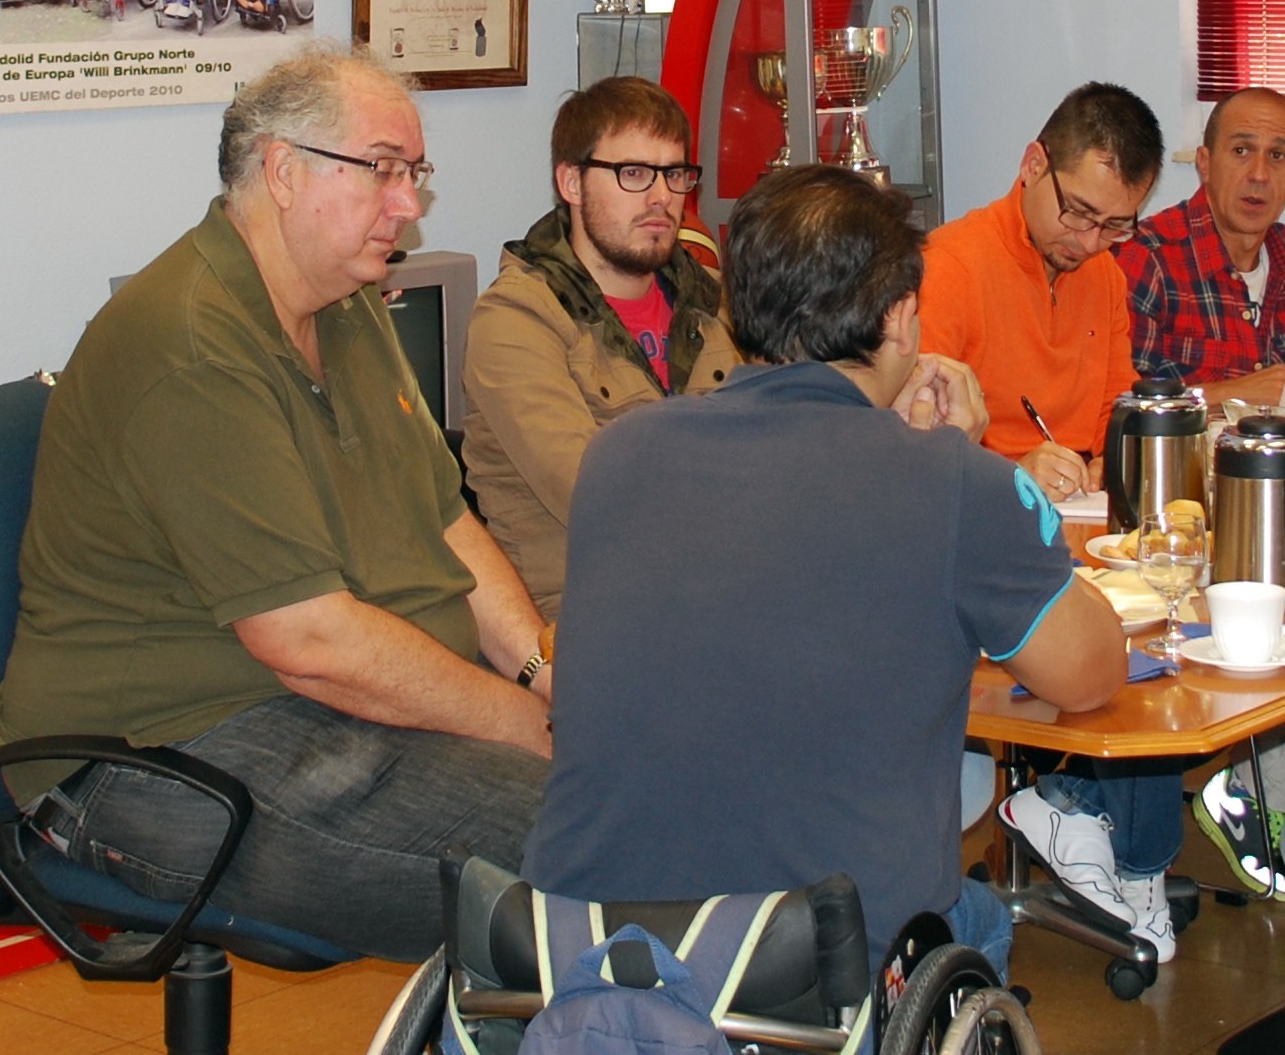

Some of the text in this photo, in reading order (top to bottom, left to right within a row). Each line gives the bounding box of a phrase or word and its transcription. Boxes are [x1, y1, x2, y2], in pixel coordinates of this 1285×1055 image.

[38, 51, 109, 64] Fundación
[114, 50, 155, 63] Grupo
[158, 48, 195, 59] Norte
[2, 70, 20, 81] de
[25, 68, 75, 81] Europa
[80, 66, 109, 78] 'Willi
[114, 64, 187, 76] Brinkmann'
[195, 62, 232, 73] 09/10
[19, 90, 61, 102] UEMC
[65, 89, 86, 100] del
[90, 87, 145, 100] Deporte
[149, 84, 183, 96] 2010
